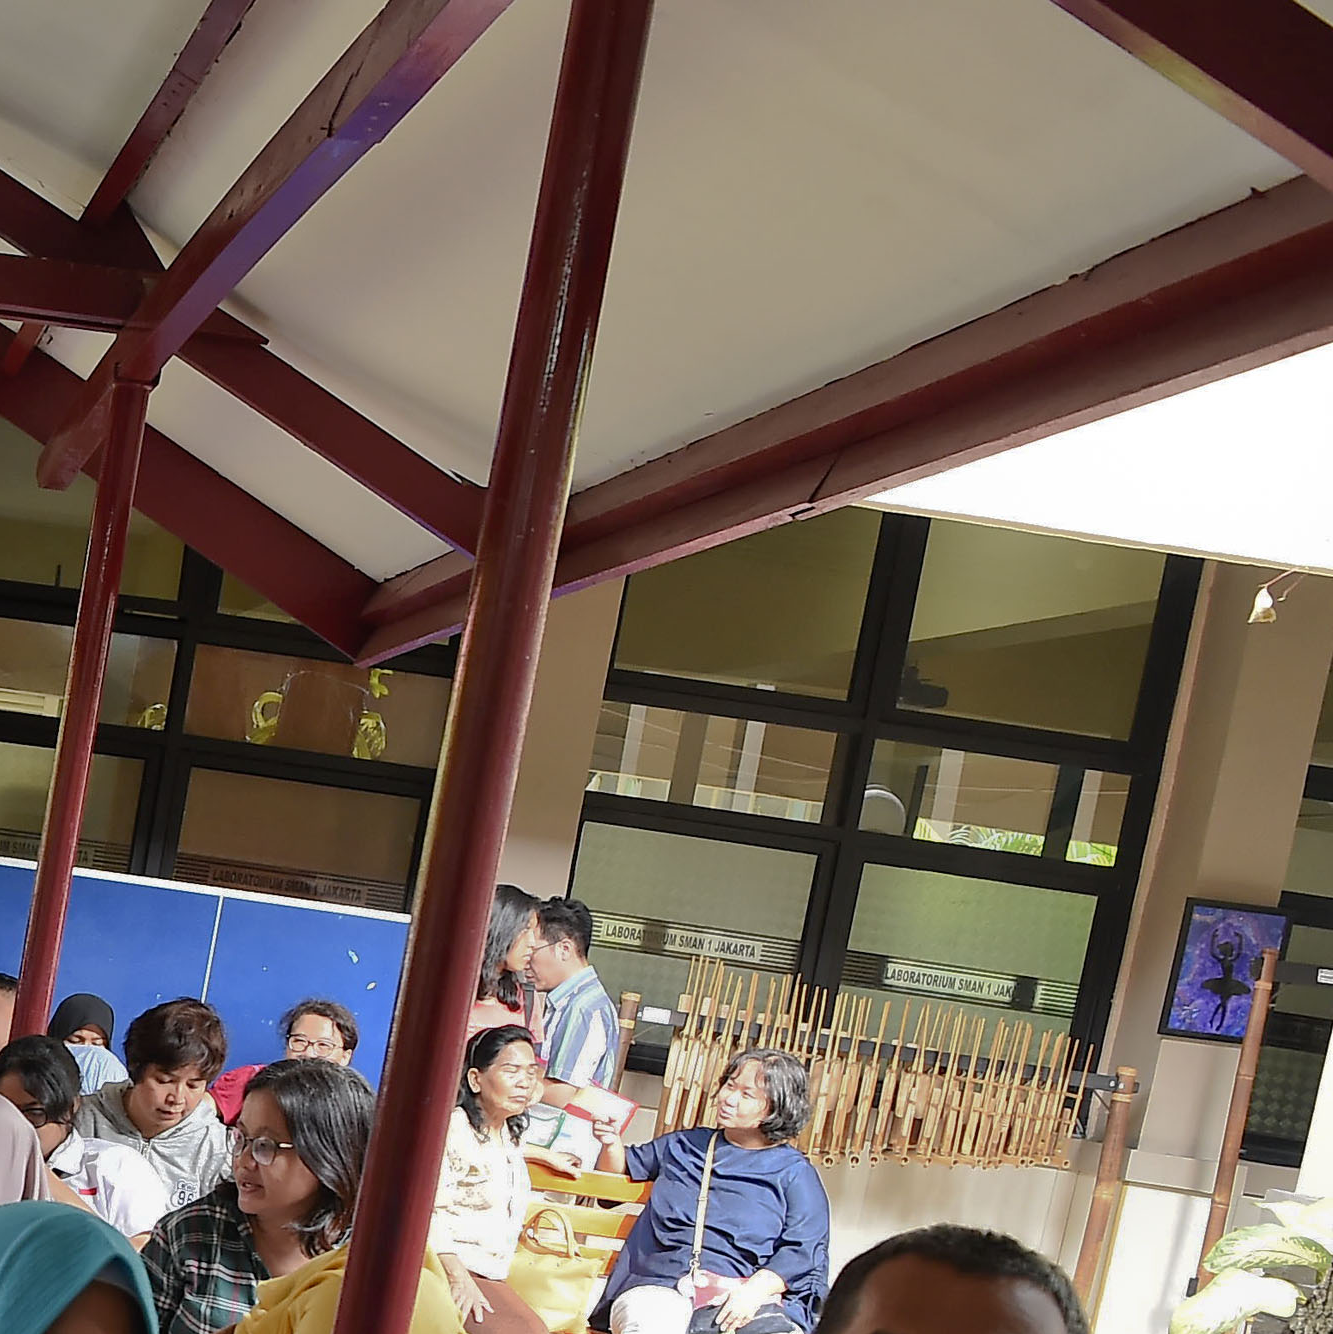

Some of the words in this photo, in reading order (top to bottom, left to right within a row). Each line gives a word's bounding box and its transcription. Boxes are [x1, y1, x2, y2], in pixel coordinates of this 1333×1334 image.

[605, 924, 677, 947] LABORATUM
[678, 935, 705, 951] SMAN
[714, 940, 757, 959] JAKARTA
[885, 967, 957, 990] LABORATORIUM
[958, 978, 984, 994] SMAN
